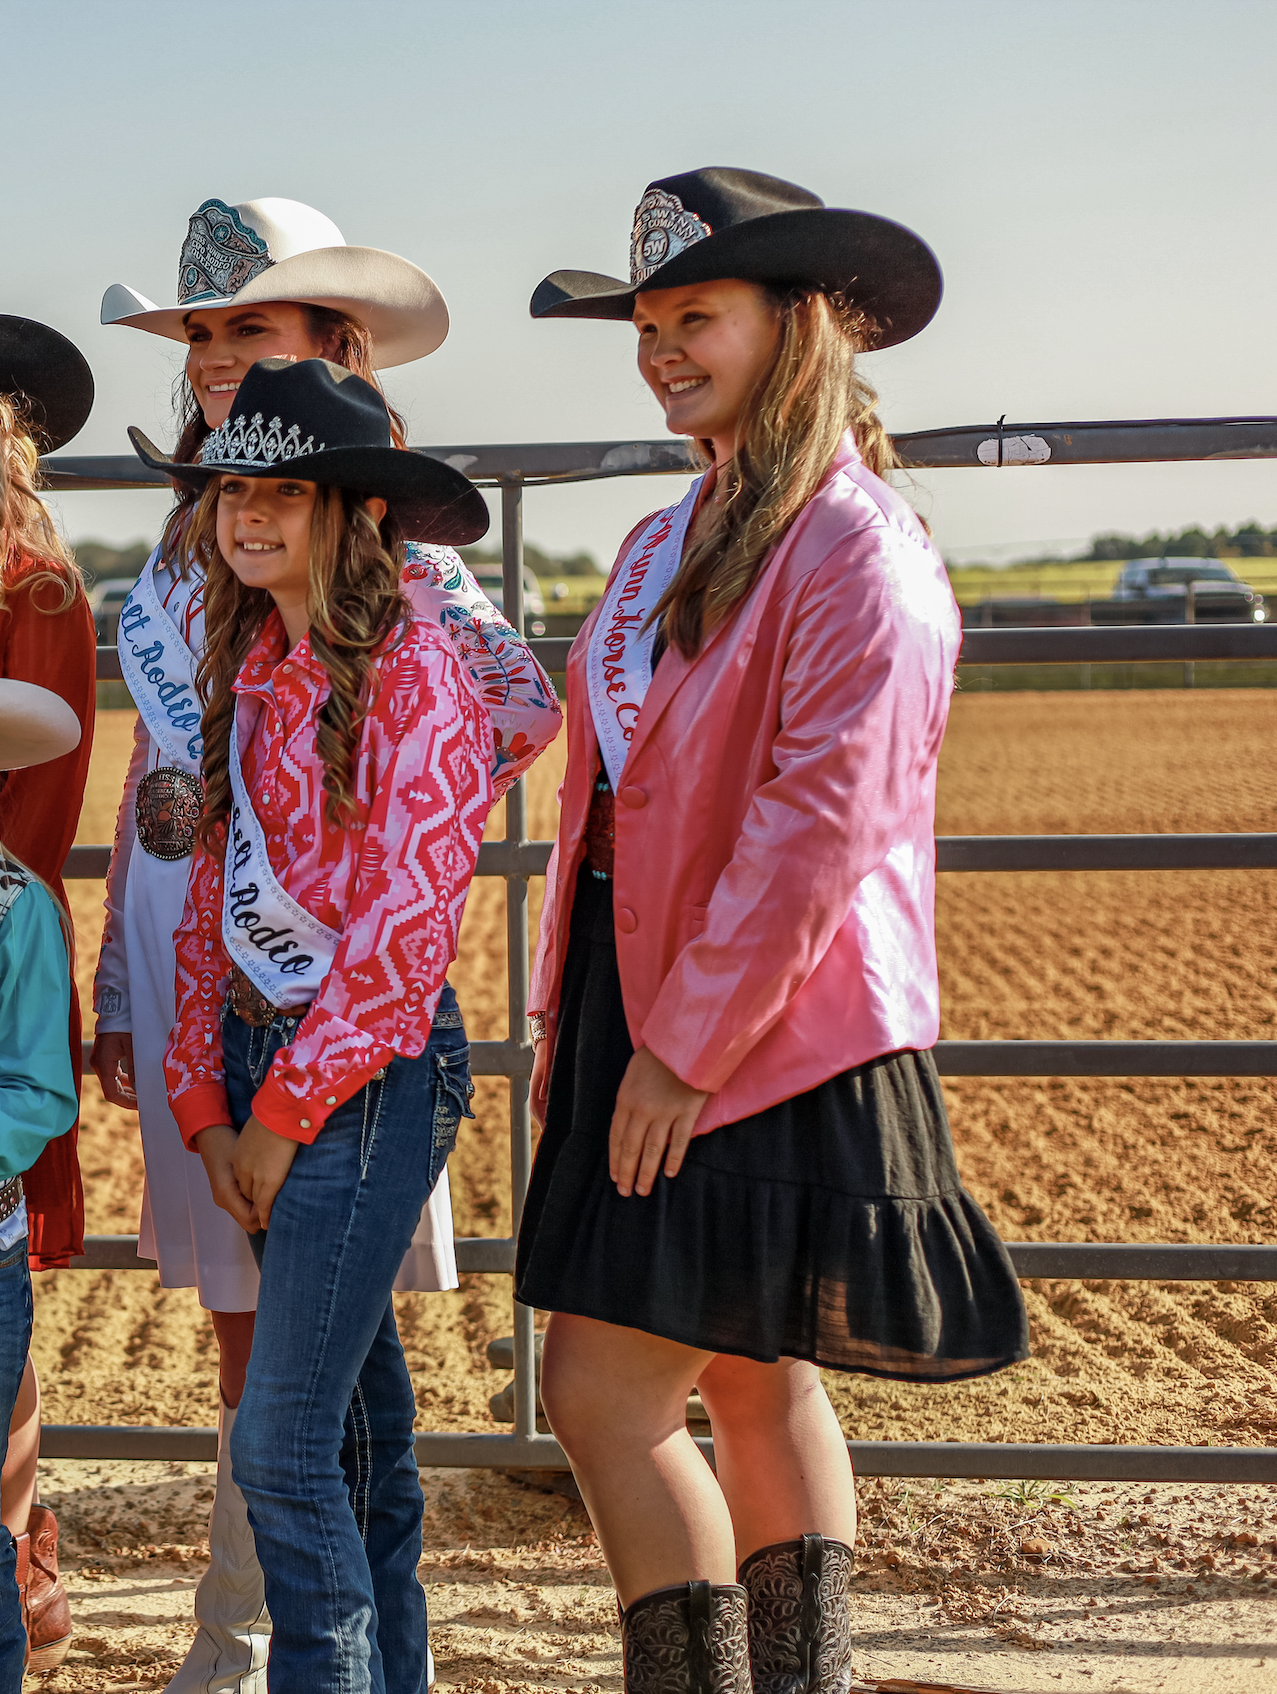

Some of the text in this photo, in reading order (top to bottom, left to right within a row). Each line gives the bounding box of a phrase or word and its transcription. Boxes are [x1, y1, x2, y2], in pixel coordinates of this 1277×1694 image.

[648, 218, 689, 242] COMPANY
[657, 209, 698, 241] WYNN
[191, 248, 218, 275] QUEEN
[206, 243, 235, 263] SUNBELT
[206, 252, 230, 270] RODEO
[643, 240, 665, 257] 5W
[602, 608, 647, 703] Horse
[131, 640, 201, 732] Rodeo
[229, 881, 314, 976] Rodeo
